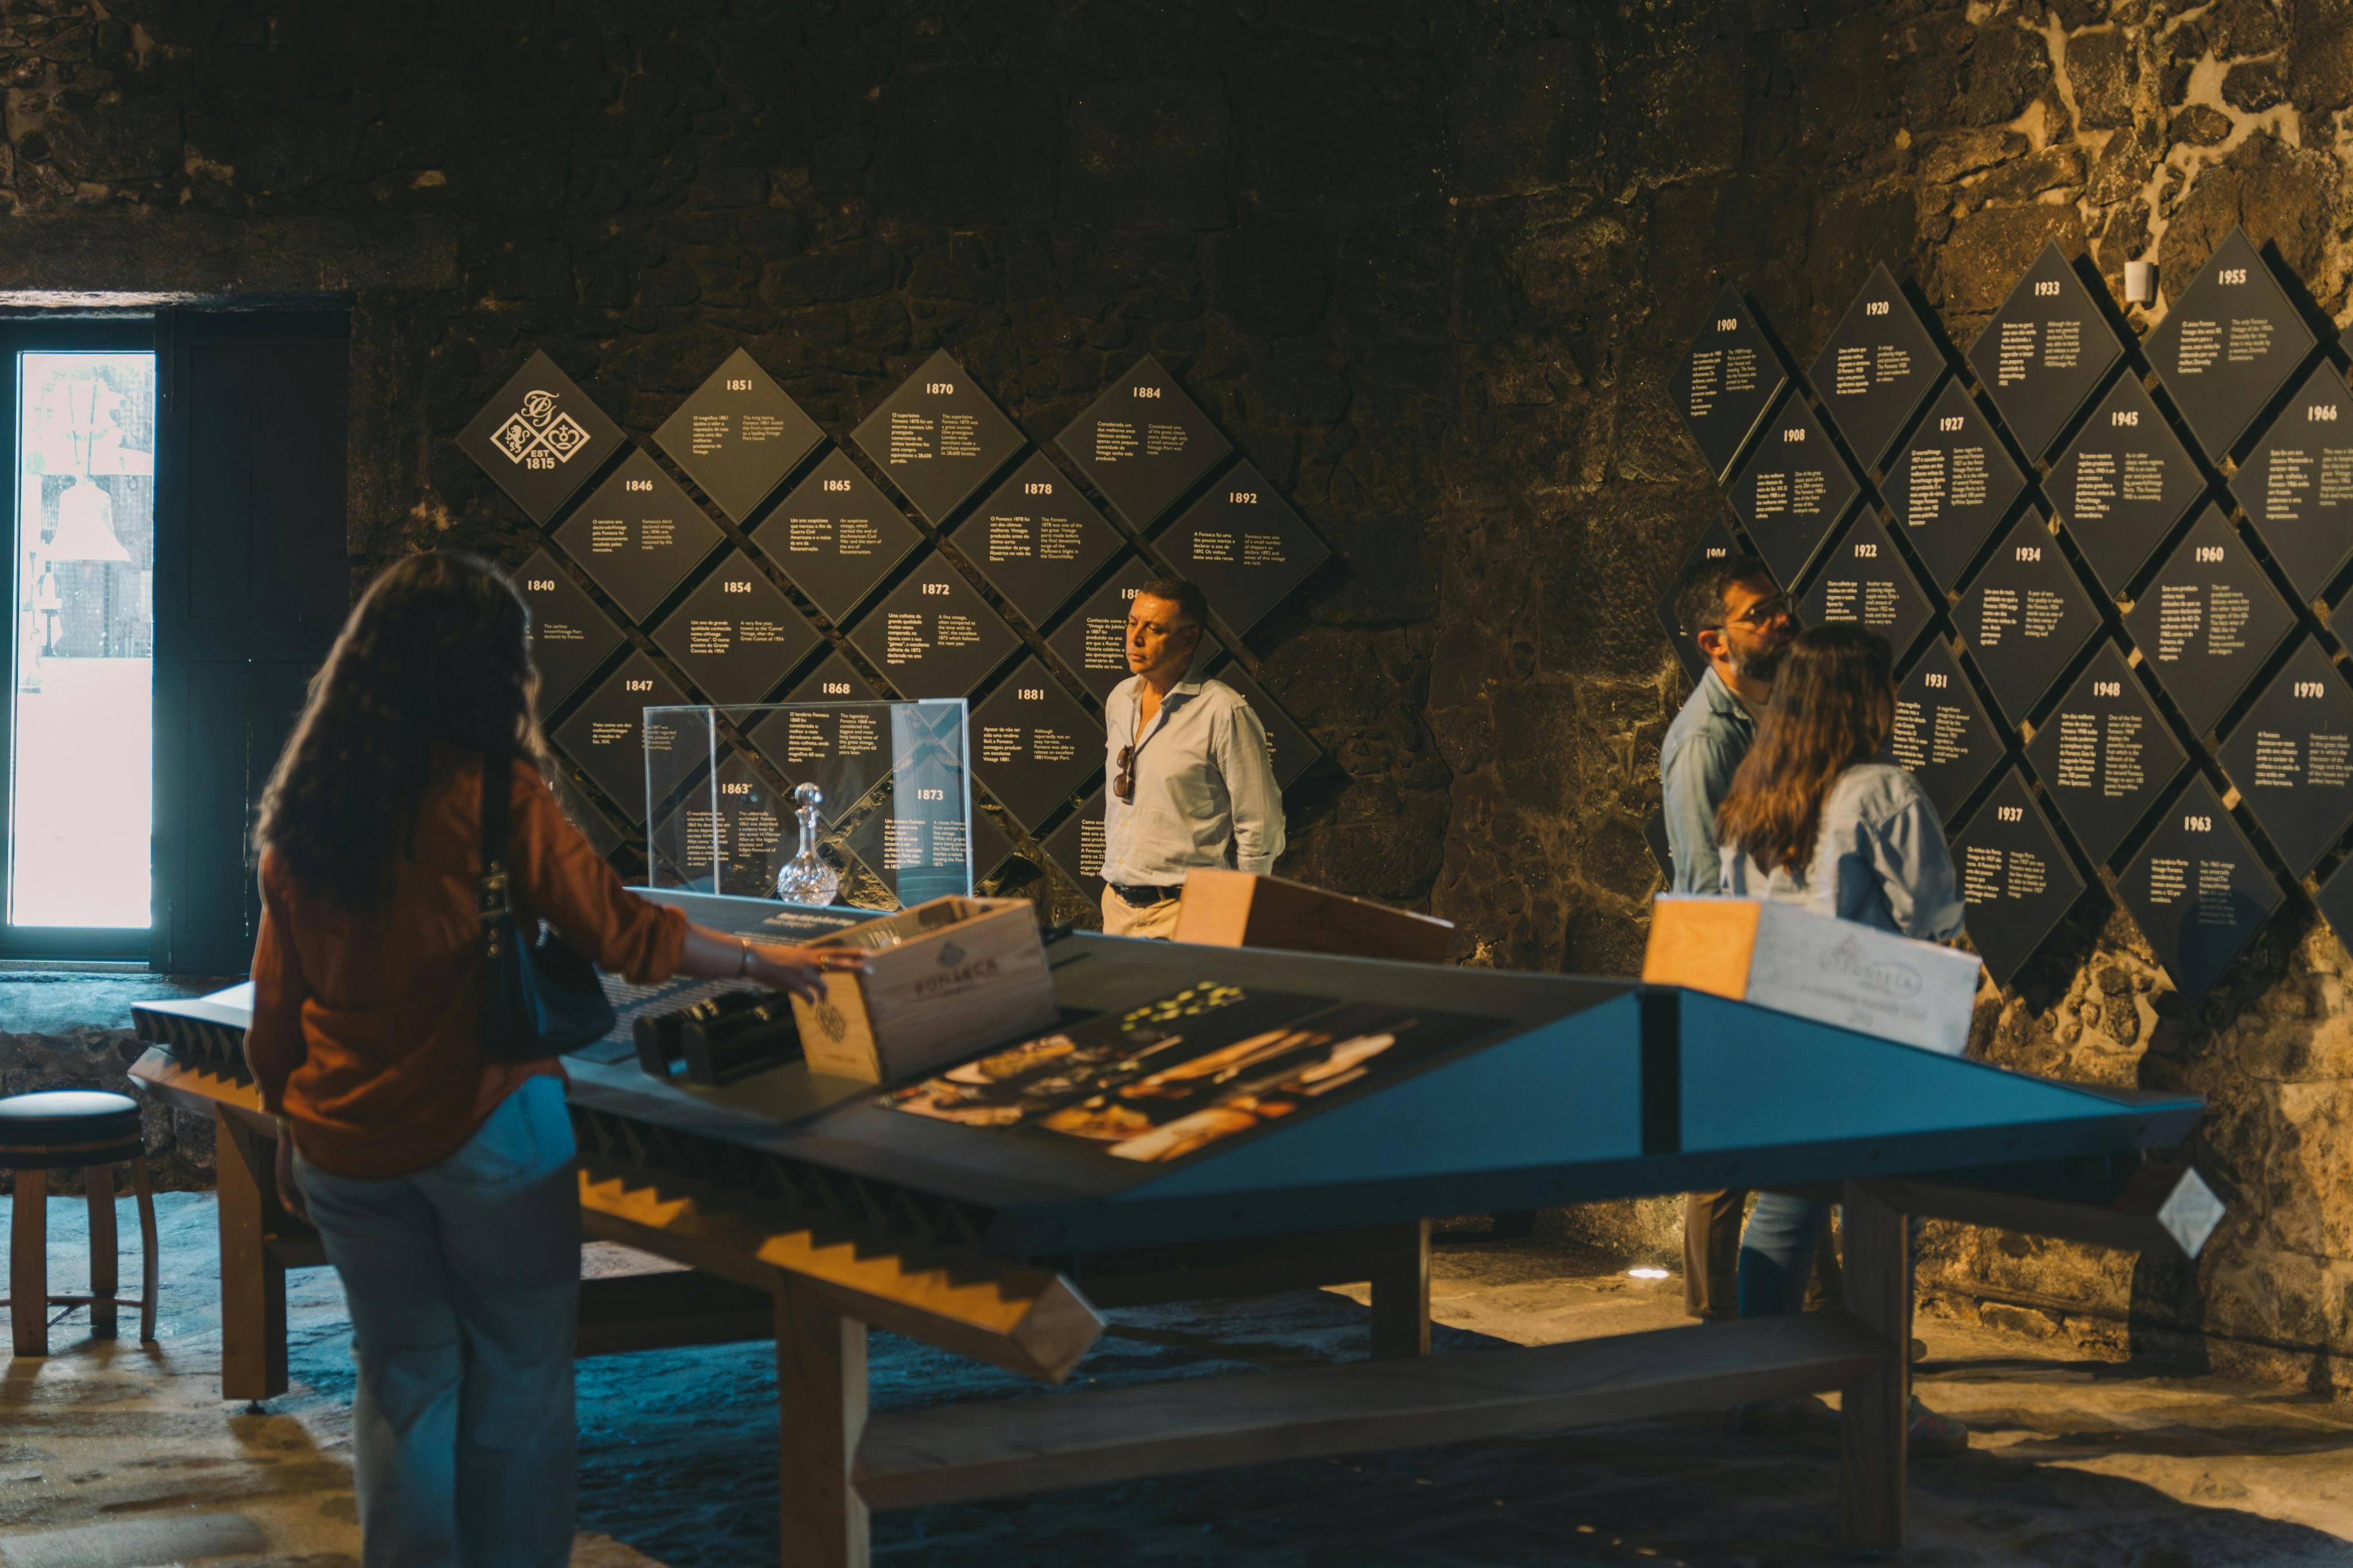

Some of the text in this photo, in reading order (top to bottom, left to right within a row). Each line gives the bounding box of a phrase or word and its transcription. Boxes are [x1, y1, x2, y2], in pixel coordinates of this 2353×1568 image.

[2219, 269, 2246, 284] 1955
[2035, 281, 2059, 295] 1933
[1867, 302, 1889, 315] 1920
[1718, 319, 1737, 331] 1900
[727, 380, 751, 390] 1851
[927, 384, 953, 394] 1870
[1134, 387, 1160, 398] 1884
[2308, 405, 2337, 420] 1966
[1941, 417, 1964, 431] 1927
[2112, 412, 2138, 426] 1945
[1784, 429, 1805, 442] 1908
[526, 458, 555, 469] 1815
[627, 481, 653, 491] 1846
[824, 480, 850, 491] 1865
[1025, 484, 1052, 494] 1878
[1230, 492, 1256, 503] 1892
[1855, 544, 1876, 557] 1922
[2016, 547, 2040, 561] 1934
[2196, 547, 2224, 562] 1960
[529, 581, 554, 590] 1840
[725, 582, 751, 592] 1854
[923, 584, 949, 594] 1872
[627, 681, 653, 690] 1847
[1926, 674, 1947, 688] 1931
[823, 683, 850, 694] 1868
[2094, 682, 2120, 697] 1948
[2294, 682, 2324, 698] 1970
[1019, 689, 1043, 700] 1881
[723, 783, 749, 794] 1863
[918, 790, 943, 800] 1873
[1999, 807, 2023, 821] 1937
[2185, 816, 2211, 831] 1963
